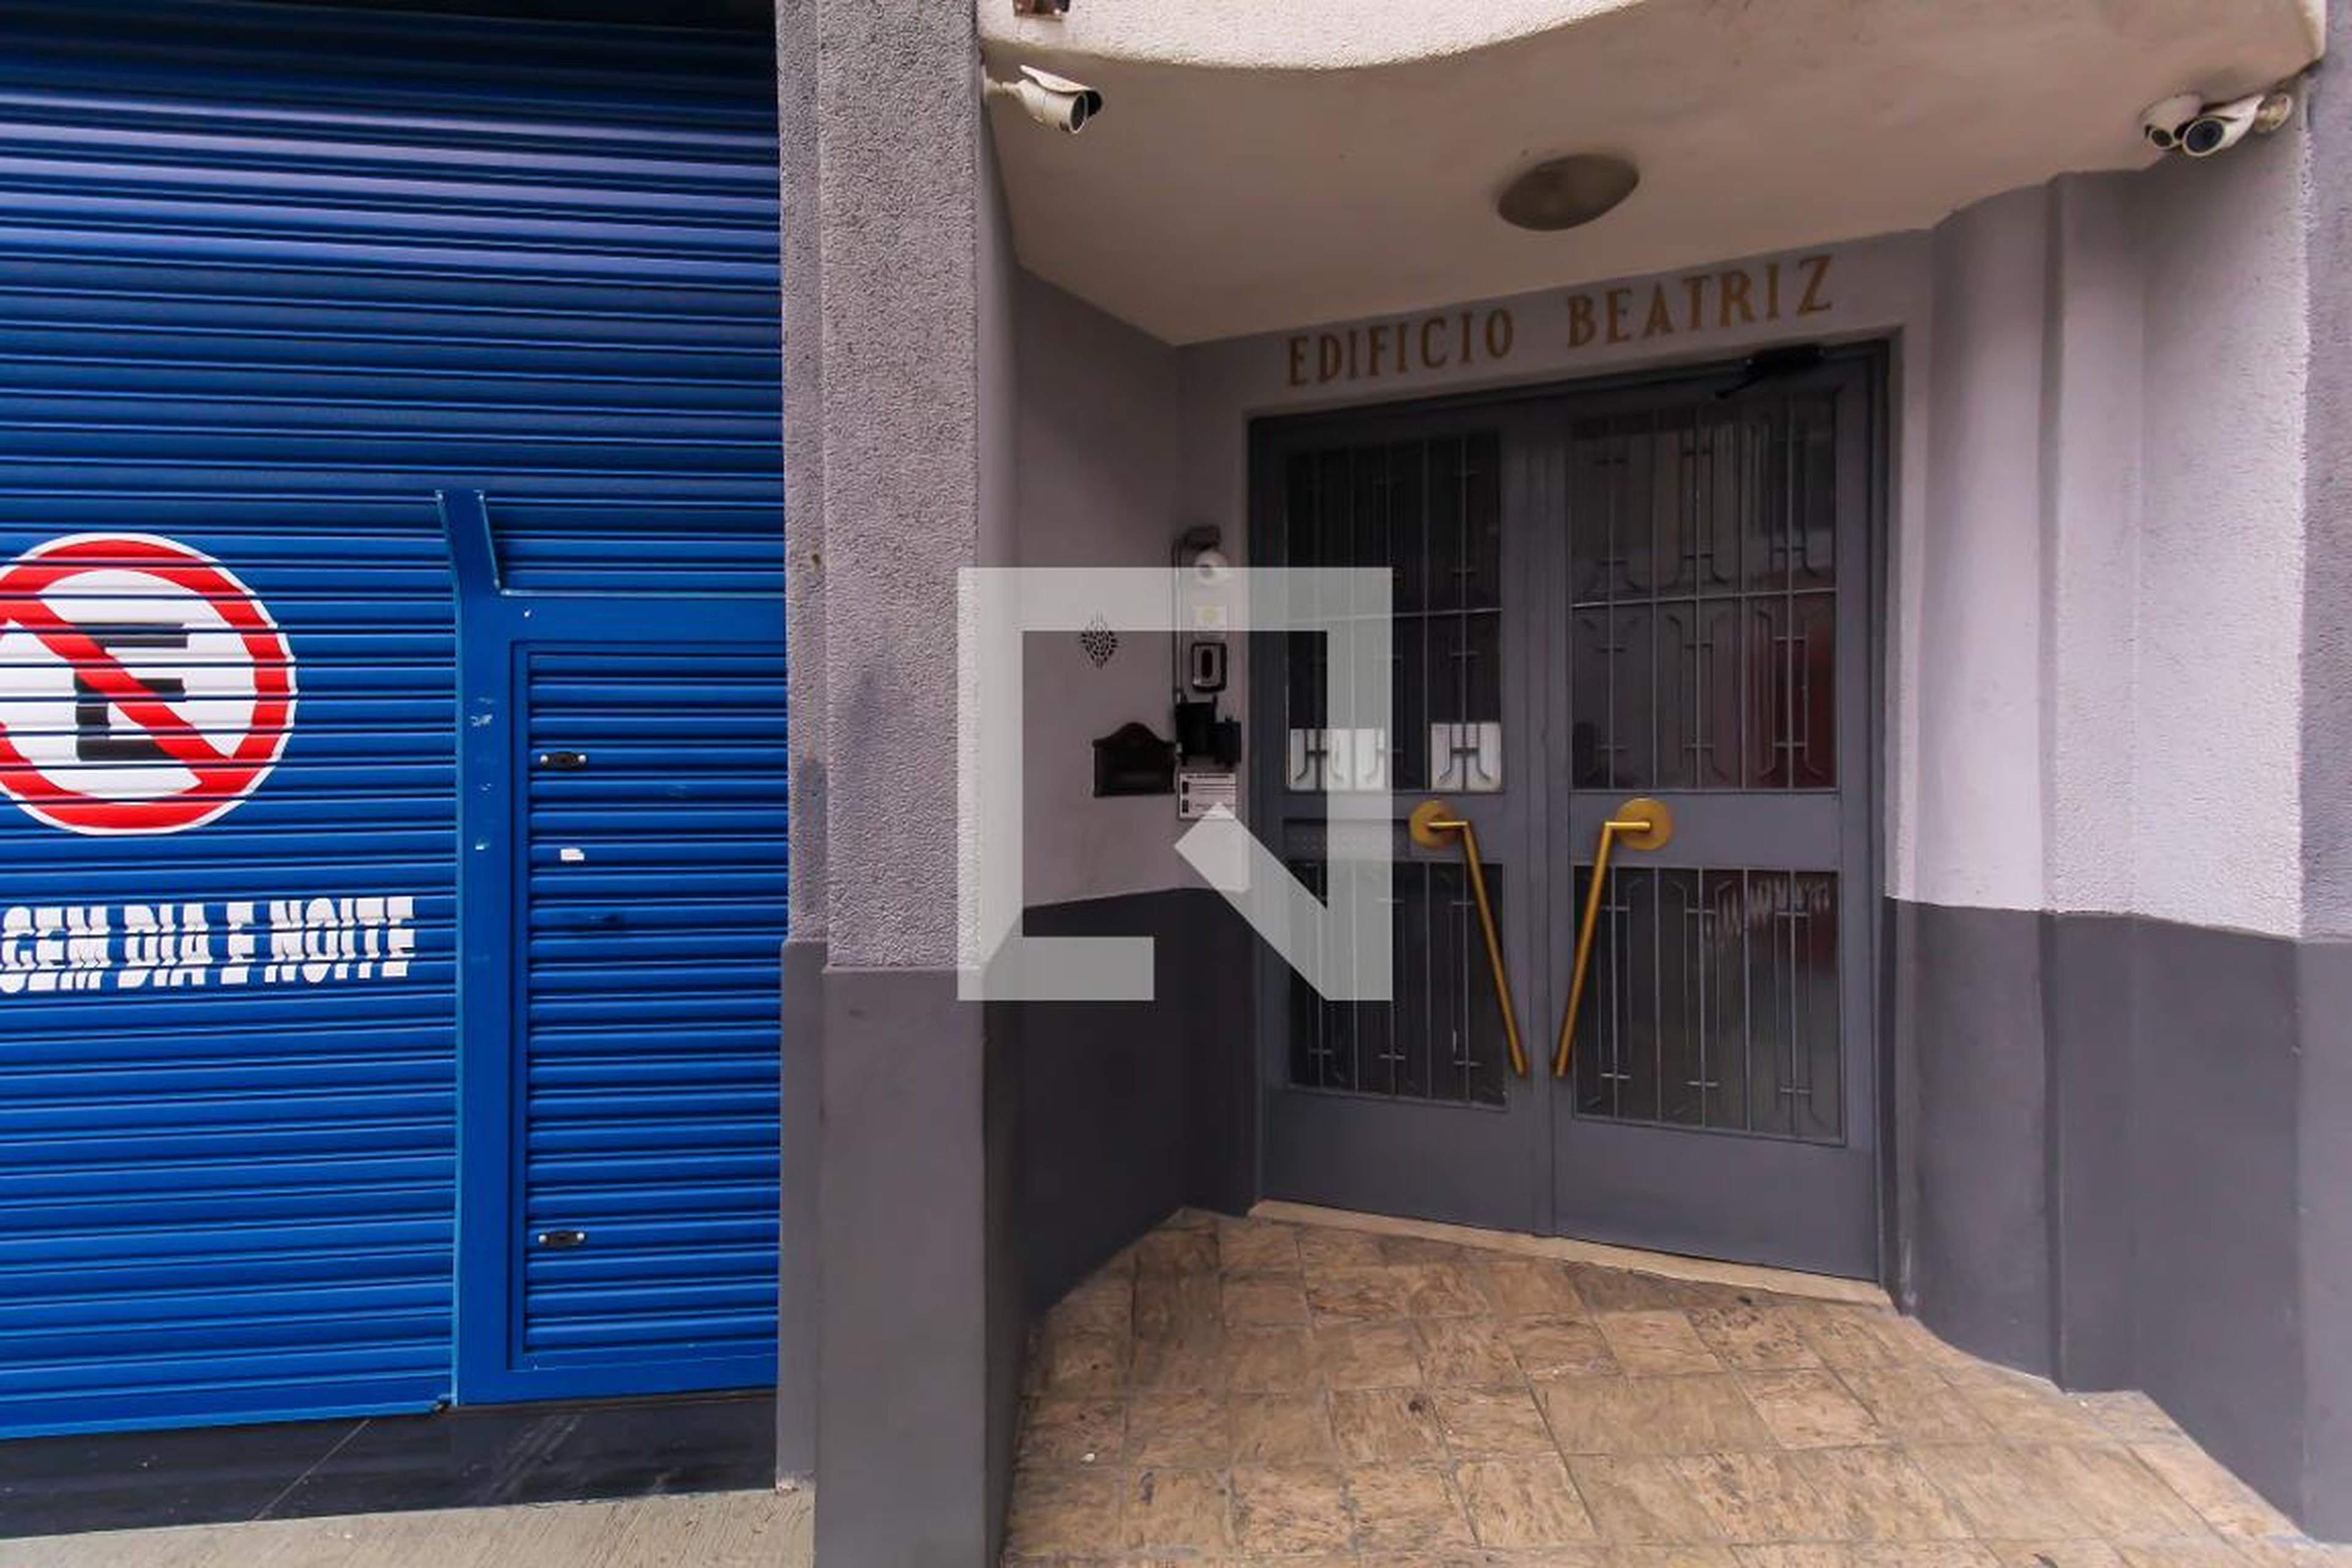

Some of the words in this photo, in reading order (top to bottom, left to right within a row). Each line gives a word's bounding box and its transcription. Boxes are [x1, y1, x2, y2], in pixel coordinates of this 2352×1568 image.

[1286, 308, 1514, 388] EDIFICIO
[1567, 255, 1833, 349] BEATRIZ
[0, 907, 111, 993] GEM
[118, 903, 212, 989] DIA
[221, 901, 255, 985] E
[264, 896, 415, 982] NOITE
